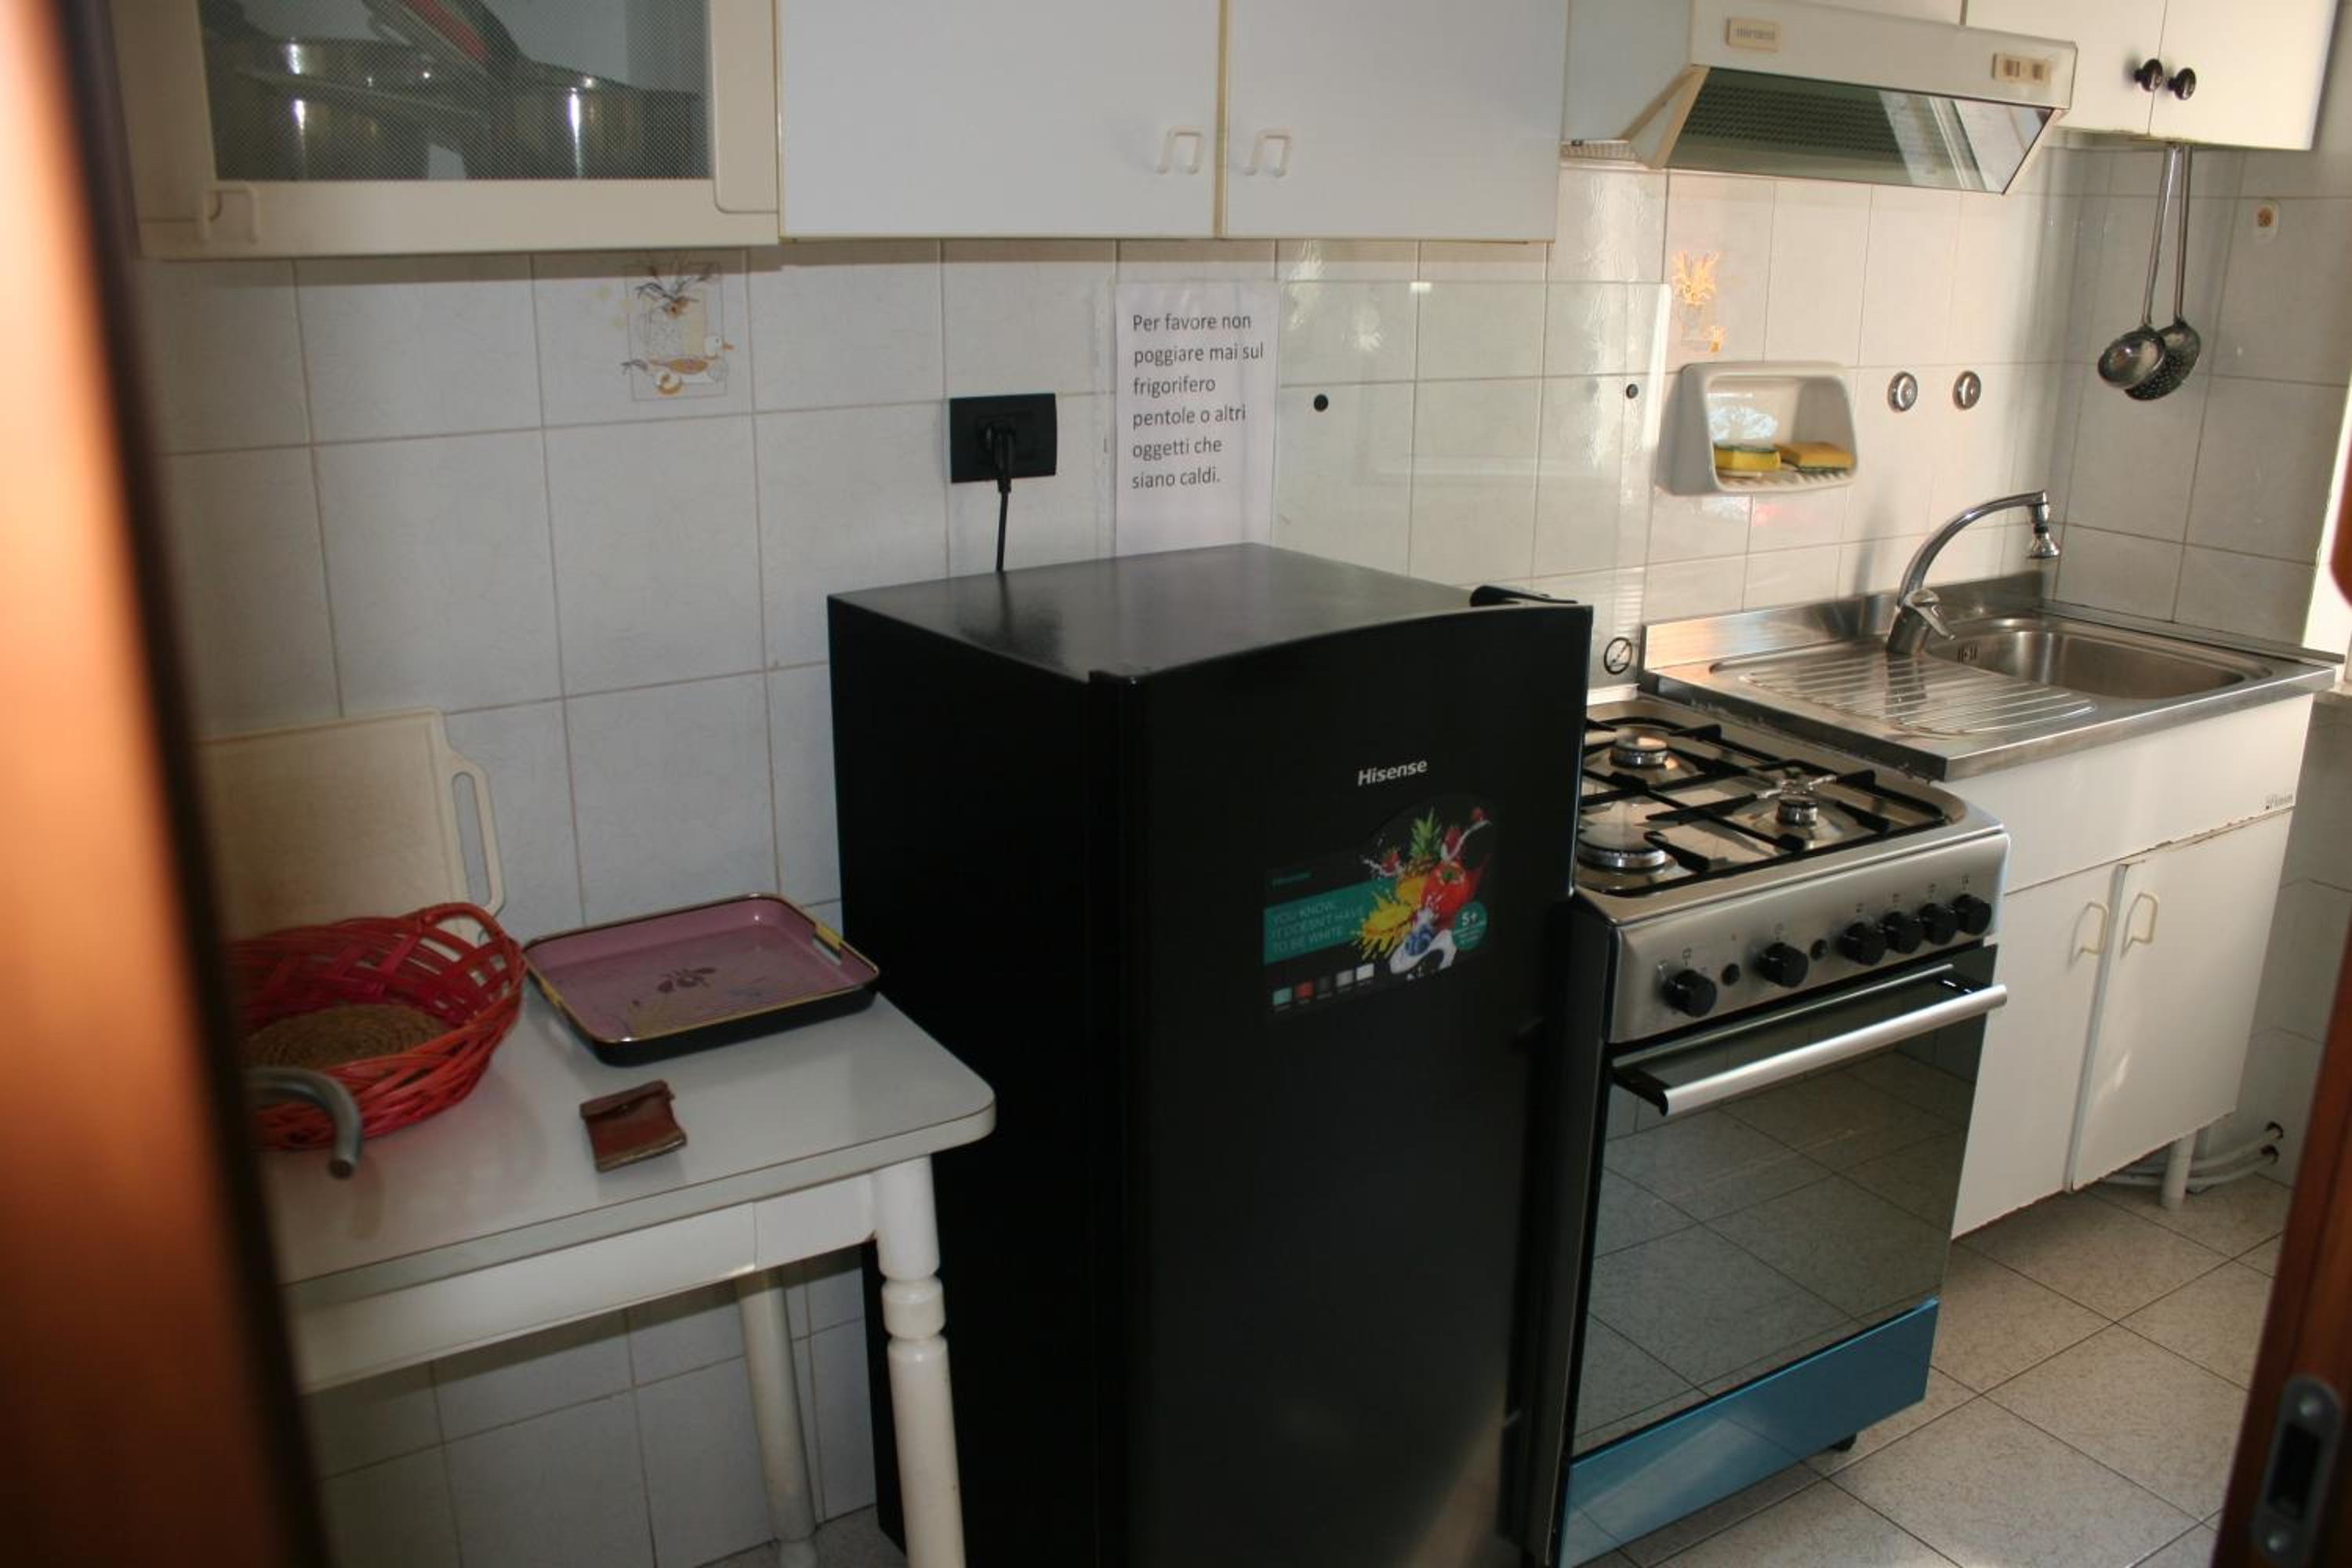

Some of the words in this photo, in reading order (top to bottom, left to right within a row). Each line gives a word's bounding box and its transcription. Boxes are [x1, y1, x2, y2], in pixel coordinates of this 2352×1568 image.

[1133, 314, 1160, 331] Per
[1165, 314, 1217, 330] favore
[1222, 315, 1251, 328] non
[1134, 346, 1204, 367] poggiare
[1210, 343, 1238, 361] mai
[1243, 342, 1264, 359] sul
[1134, 376, 1216, 398] frigorifero
[1133, 407, 1196, 430] pentole
[1200, 409, 1210, 423] o
[1214, 404, 1246, 422] altri
[1133, 439, 1189, 461] oggetti
[1194, 437, 1222, 453] che
[1132, 473, 1175, 488] siano
[1180, 466, 1221, 485] caldi.
[1358, 760, 1428, 786] Hisense
